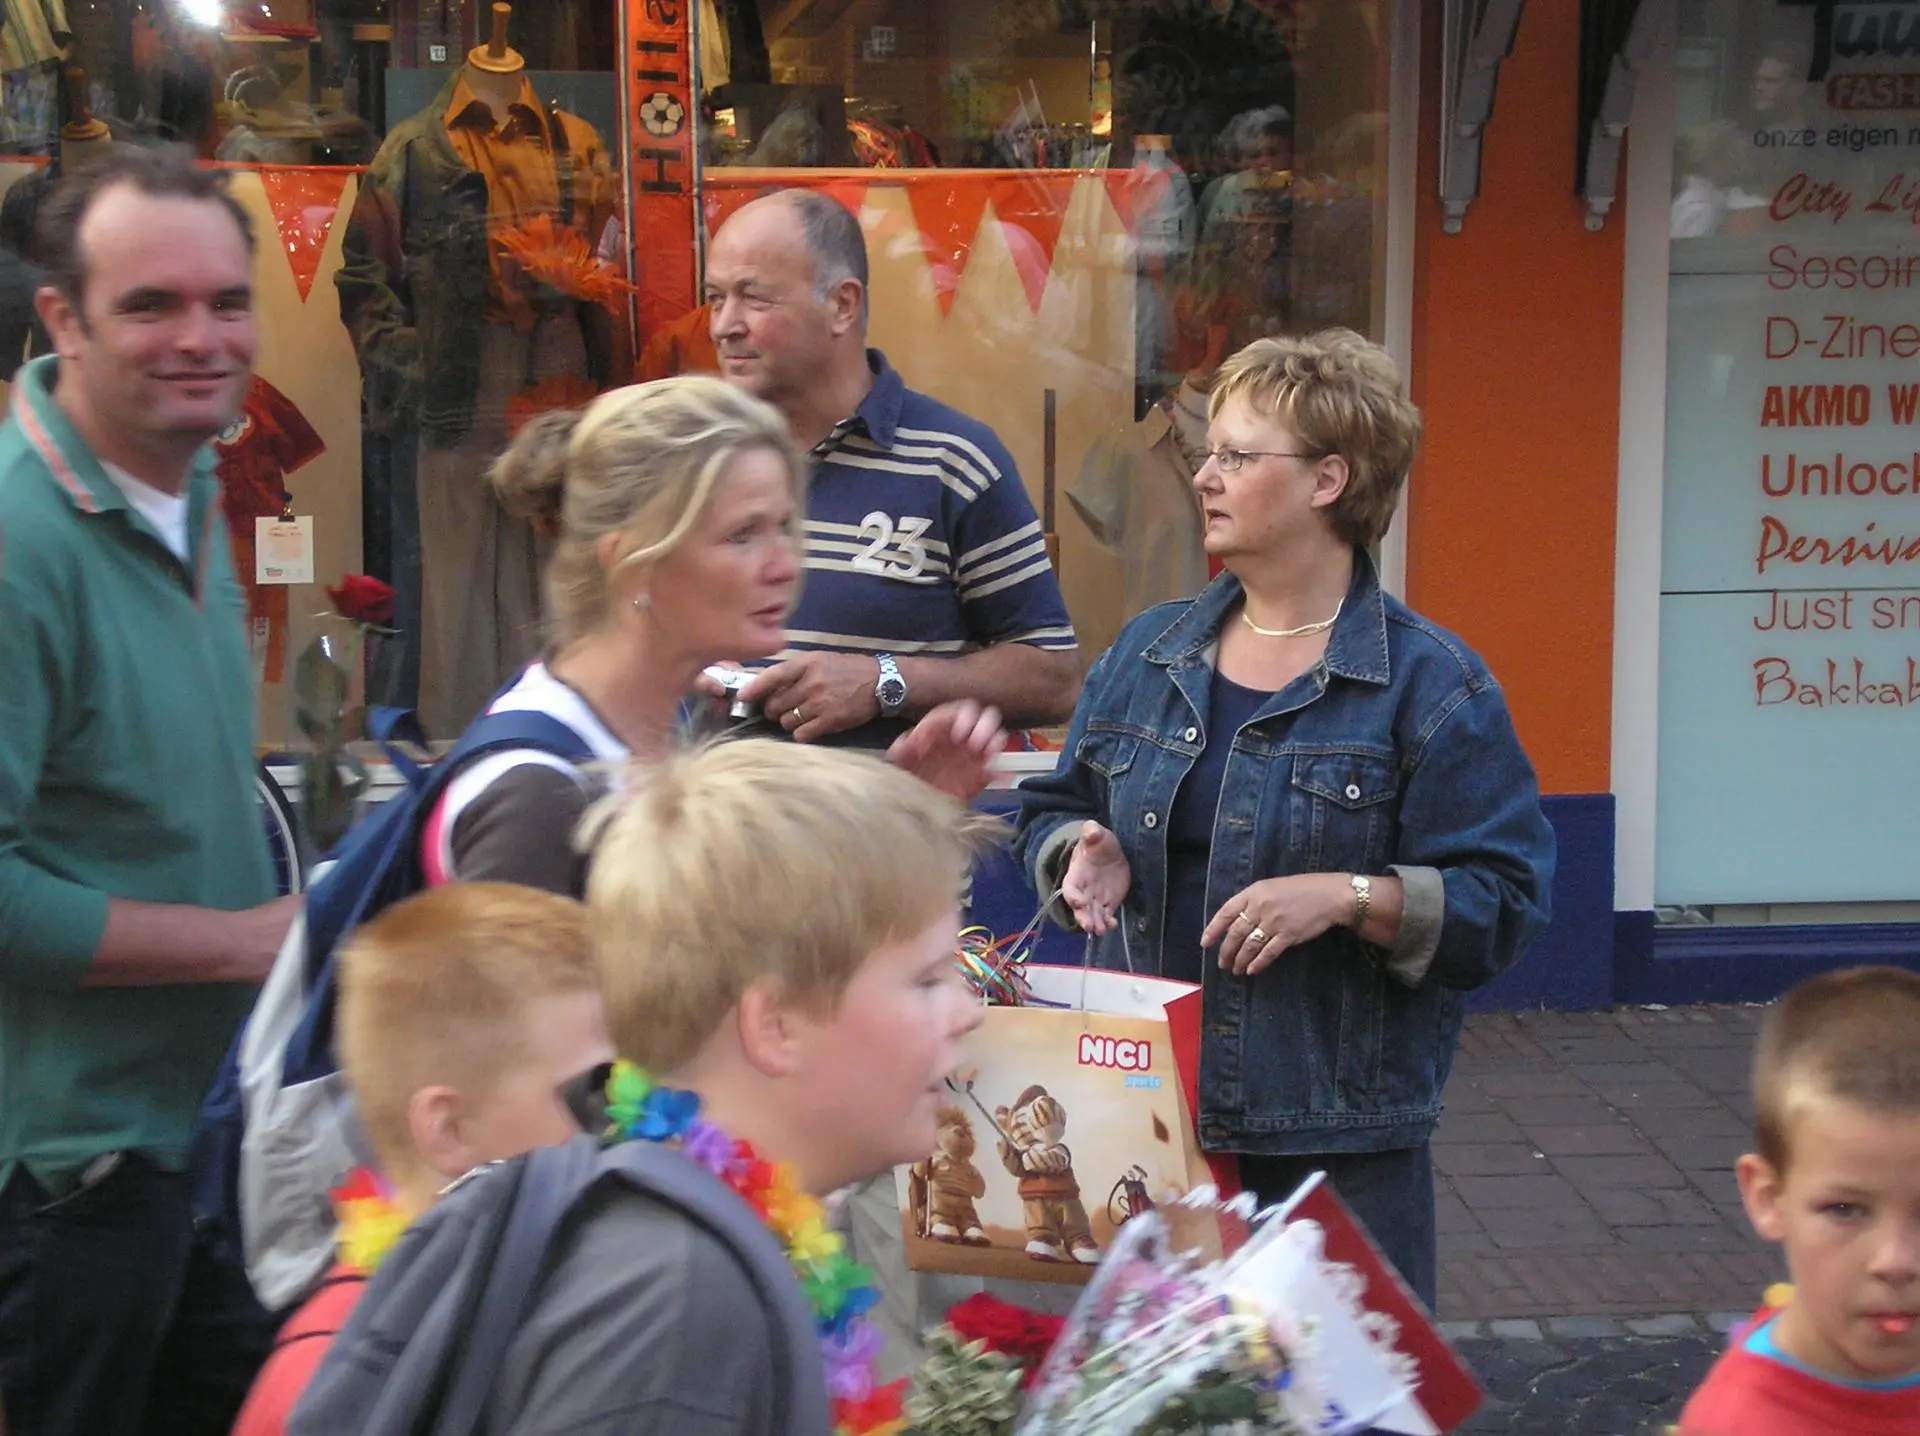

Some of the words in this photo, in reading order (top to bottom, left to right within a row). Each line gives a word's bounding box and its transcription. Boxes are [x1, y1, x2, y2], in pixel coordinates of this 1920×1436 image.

[1754, 129, 1816, 148] onze
[1826, 123, 1898, 152] eigen
[1769, 172, 1851, 224] City
[1764, 316, 1920, 360] D-Zine
[1760, 384, 1871, 427] AKMO
[852, 510, 934, 578] 23
[1753, 589, 1852, 631] Just
[1078, 1033, 1152, 1071] NICI
